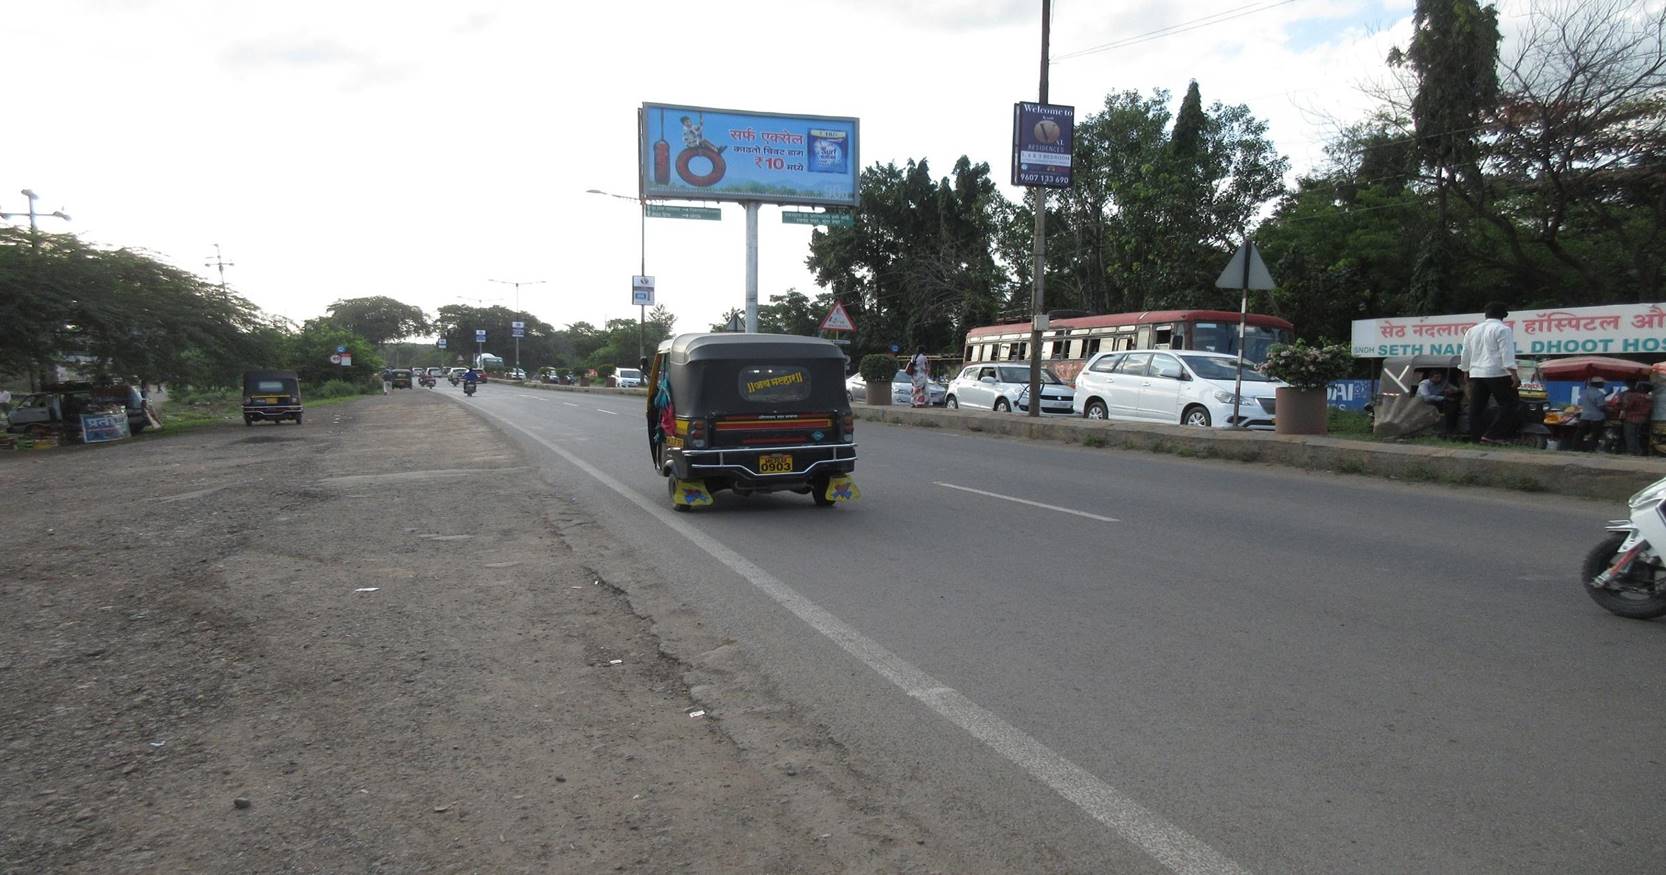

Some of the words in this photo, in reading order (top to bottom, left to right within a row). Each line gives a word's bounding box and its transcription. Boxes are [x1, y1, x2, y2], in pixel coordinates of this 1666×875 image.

[1024, 104, 1063, 115] Welcome
[730, 128, 756, 142] सर्फ
[761, 129, 804, 144] एक्सेल
[1028, 144, 1064, 153] RESIDENCES
[1021, 173, 1039, 182] 9607
[1041, 174, 1054, 183] 133
[1055, 176, 1069, 184] 690
[1380, 321, 1407, 338] सेठ
[1523, 312, 1621, 335] हॉस्पिटल
[1378, 344, 1424, 356] SETH
[1531, 339, 1613, 353] DHOOT
[761, 462, 792, 471] 0903
